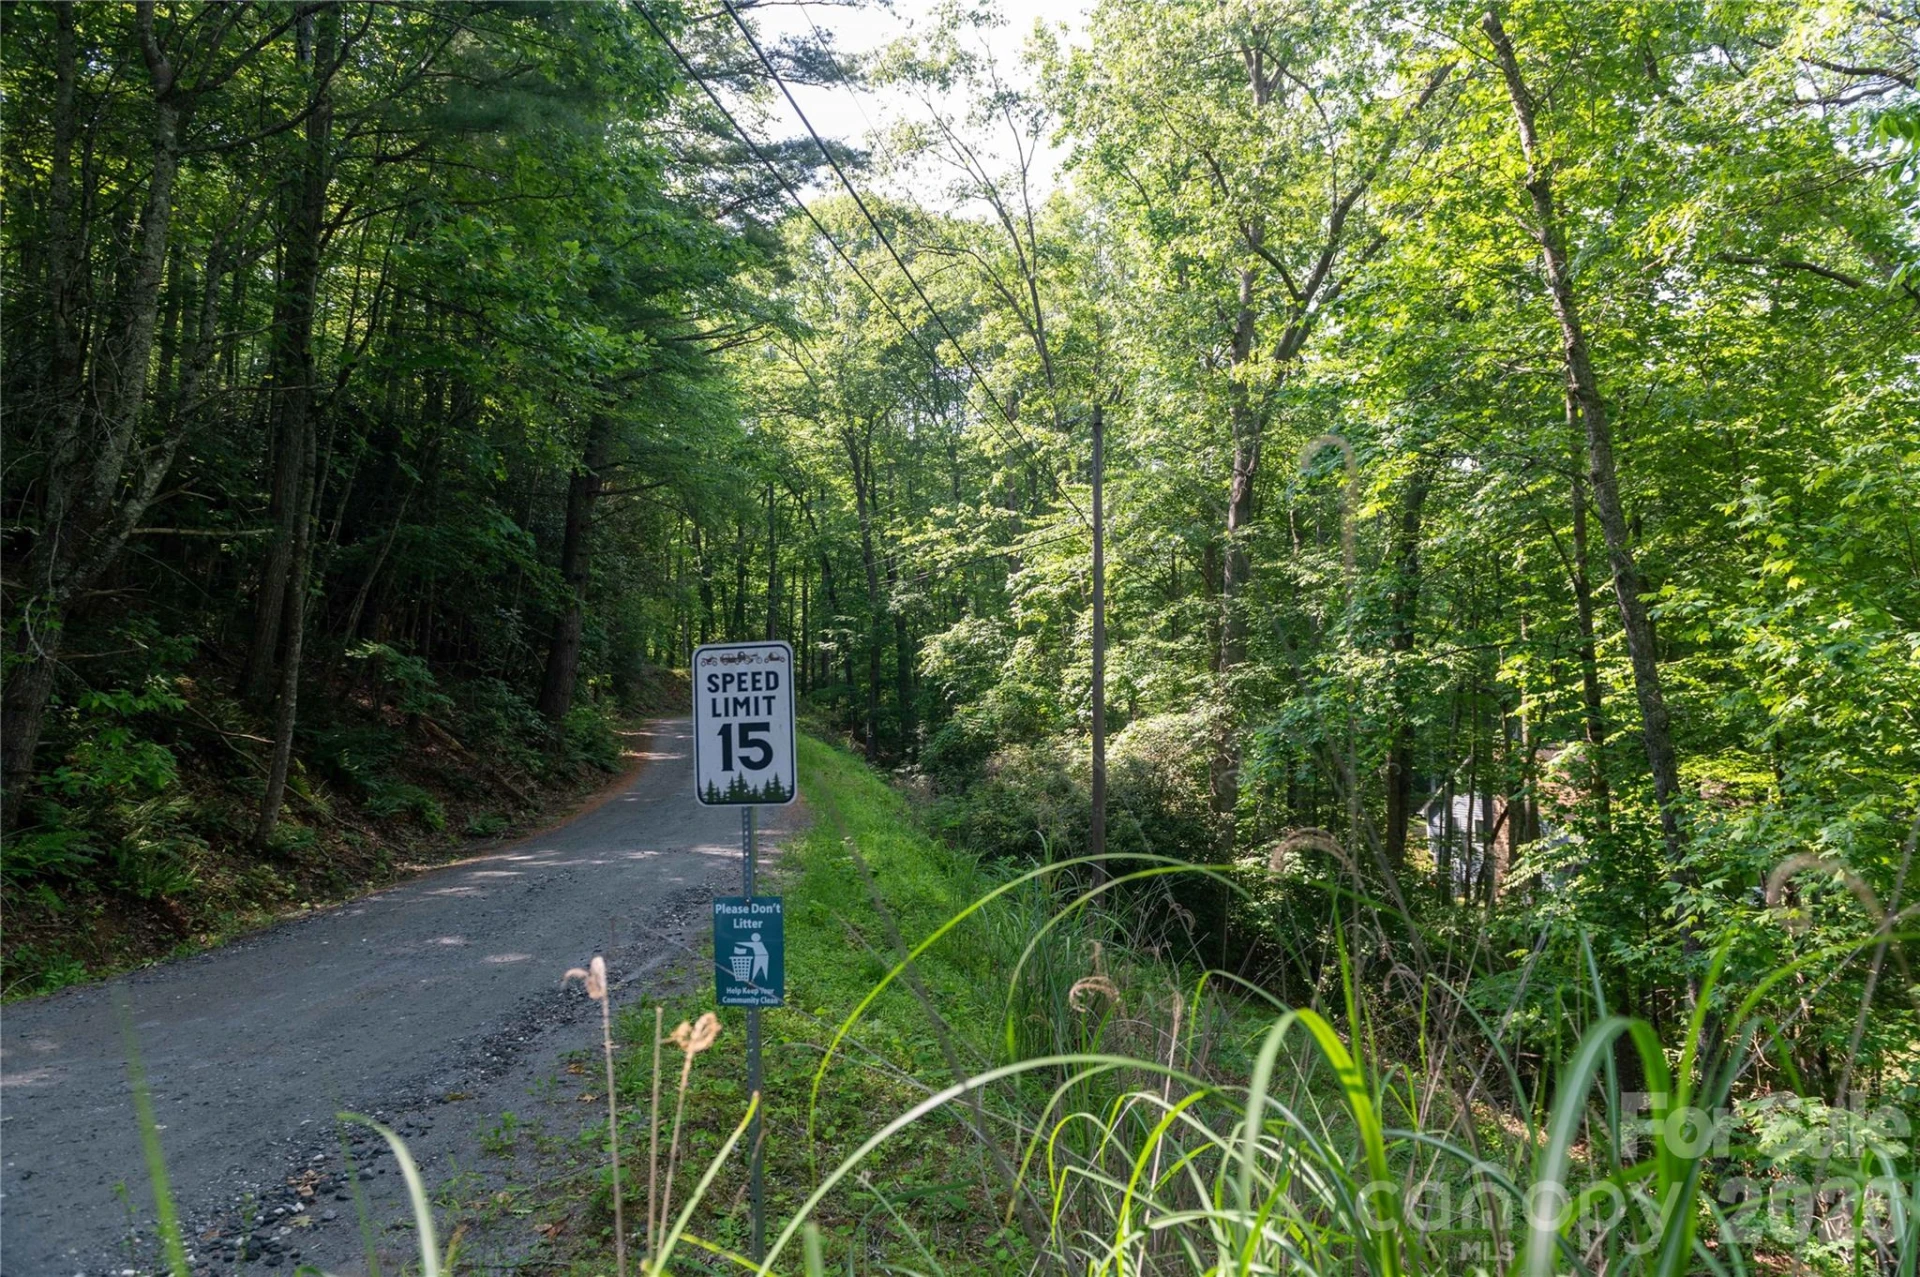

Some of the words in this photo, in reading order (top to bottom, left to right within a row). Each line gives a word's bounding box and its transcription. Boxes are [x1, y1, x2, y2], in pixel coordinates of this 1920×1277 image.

[707, 671, 779, 693] SPEED
[712, 695, 776, 718] LIMIT
[717, 722, 774, 772] 15
[715, 903, 749, 914] Please
[751, 903, 781, 914] Don't
[733, 918, 763, 929] Litter
[726, 987, 741, 995] Help
[742, 987, 759, 996] Keep
[722, 996, 759, 1005] Community
[761, 996, 778, 1004] Clean
